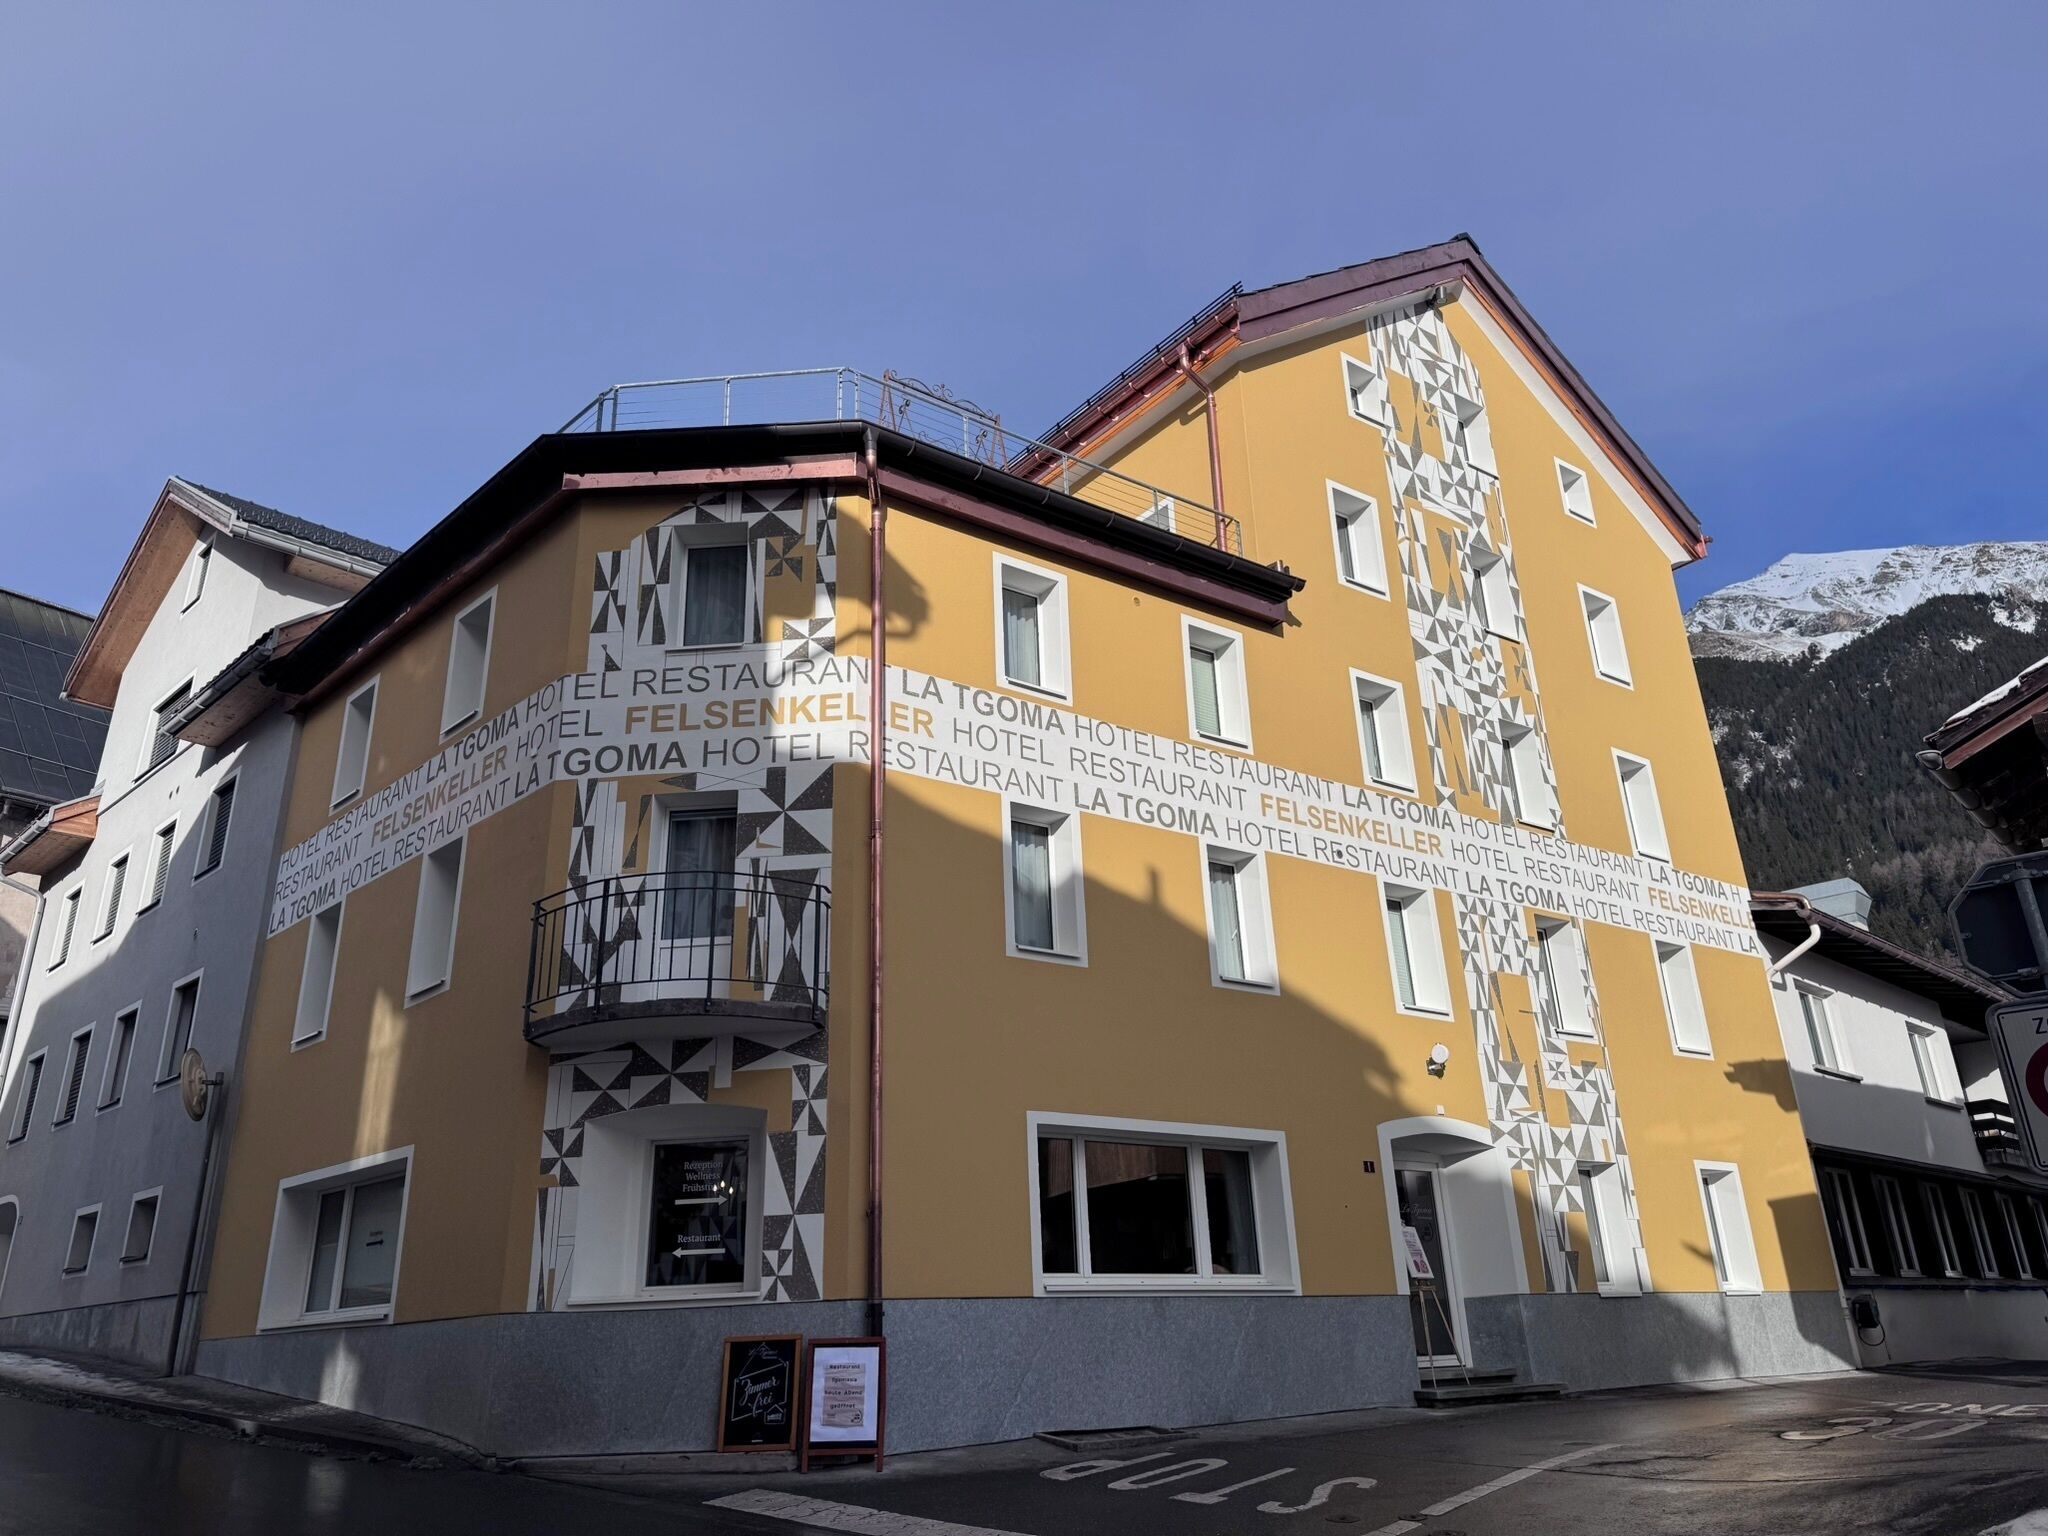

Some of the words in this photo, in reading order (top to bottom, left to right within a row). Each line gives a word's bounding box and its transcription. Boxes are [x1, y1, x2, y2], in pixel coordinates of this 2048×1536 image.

[280, 831, 321, 873] HOTEL
[326, 767, 428, 843] RESTAURANT
[426, 751, 447, 784] LA
[454, 707, 518, 761] TGOMA
[525, 672, 619, 722] HOTEL
[632, 657, 892, 696] RESTAURAN
[902, 669, 943, 704] LA
[952, 681, 1065, 735] TGOMA
[1074, 715, 1165, 761] HOTEL
[1173, 740, 1334, 802] RESTAURANT
[1342, 784, 1372, 812] LA
[1376, 794, 1456, 832] TGOMA
[1460, 814, 1526, 850] HOTEL
[1529, 832, 1645, 879] RESTAURANT
[1648, 862, 1671, 888] LA
[1672, 869, 1729, 899] TGOMA
[1729, 884, 1742, 904] H
[275, 834, 362, 902] RESTAURANT
[371, 745, 508, 847] FELSENKELLER
[516, 709, 603, 762] HOTEL
[625, 692, 934, 739] FELSENKELER
[953, 717, 1055, 767] HOTEL
[1070, 746, 1247, 812] RESTAURANT
[1260, 793, 1444, 858] FELSENKELLER
[1451, 839, 1519, 875] HOTEL
[1523, 856, 1640, 903] RESTAURANT
[269, 910, 285, 935] LA
[289, 884, 336, 921] TGOMA
[340, 854, 388, 896] HOTEL
[393, 778, 510, 868] RESTAURANT
[514, 761, 540, 798] LA
[547, 741, 688, 780] TGOMA
[702, 732, 835, 767] HOTEL
[1074, 782, 1111, 815] LA
[1117, 792, 1219, 838] TGOMA
[1225, 817, 1308, 857] HOTEL
[1313, 837, 1458, 890] RESTAURANT
[1466, 872, 1492, 898] LA
[1496, 878, 1570, 913] TGOMA
[1572, 896, 1632, 927] HOTEL
[1633, 909, 1742, 948] RESTAURANT
[1737, 933, 1760, 955] LA
[2032, 1016, 2048, 1034] Z
[684, 1160, 723, 1171] Rezeption
[686, 1171, 721, 1181] Wellness
[677, 1234, 721, 1244] Restaurant
[739, 1377, 778, 1406] Zimmer
[1779, 1416, 1988, 1441] 30
[1039, 1452, 1378, 1514] STOP
